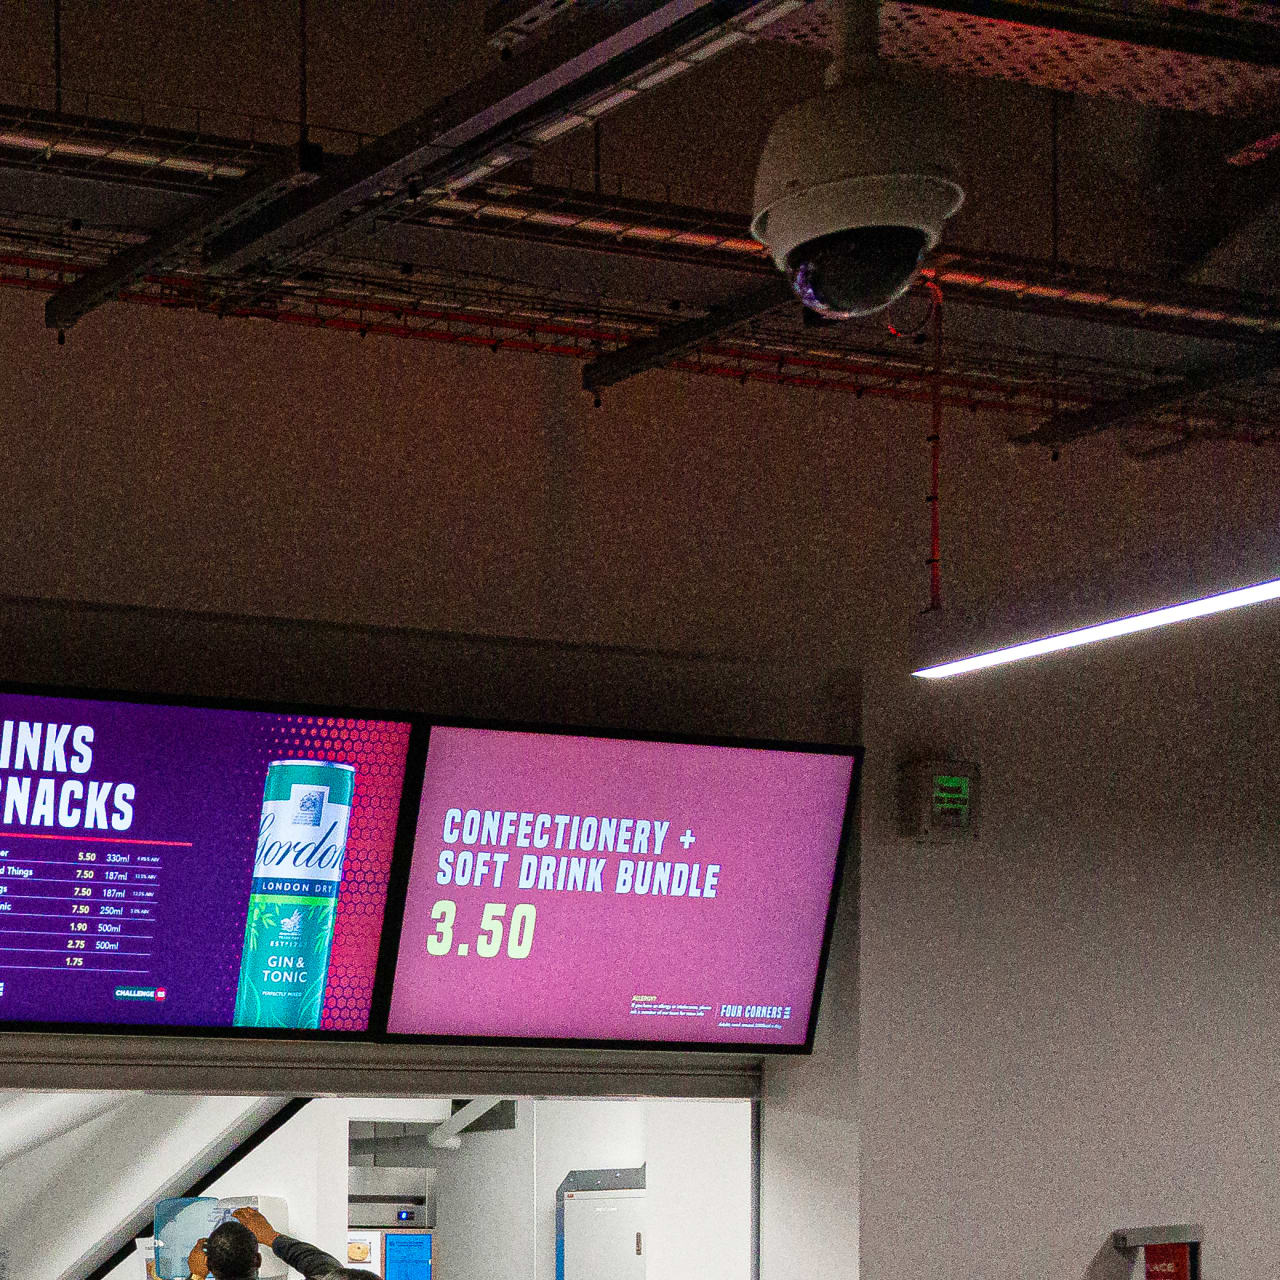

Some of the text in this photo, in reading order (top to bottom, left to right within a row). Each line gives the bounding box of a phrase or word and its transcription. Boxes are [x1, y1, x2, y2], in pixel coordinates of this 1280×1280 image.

[442, 807, 696, 855] CONFECTIONERY +
[78, 852, 96, 861] 5.50
[106, 853, 130, 863] 330ml
[7, 867, 33, 877] Things
[77, 870, 94, 879] 7.50
[105, 871, 127, 880] 187ml
[436, 850, 721, 899] SOFT DRINK BUNDLE
[74, 888, 91, 896] 7.50
[103, 889, 125, 898] 187ml
[262, 881, 333, 893] LONDON DRY
[72, 905, 89, 914] 7.50
[100, 906, 123, 915] 250ml
[70, 923, 87, 931] 1.90
[98, 923, 120, 933] 500ml
[426, 900, 538, 960] 3.50
[67, 940, 85, 948] 2.75
[96, 941, 118, 950] 500ml
[66, 957, 83, 966] 1.75
[268, 955, 304, 968] GIN &
[262, 969, 307, 983] TONIC
[115, 990, 154, 998] CHALLENGE
[720, 1005, 742, 1017] FOUR
[745, 1005, 782, 1019] CORNERS
